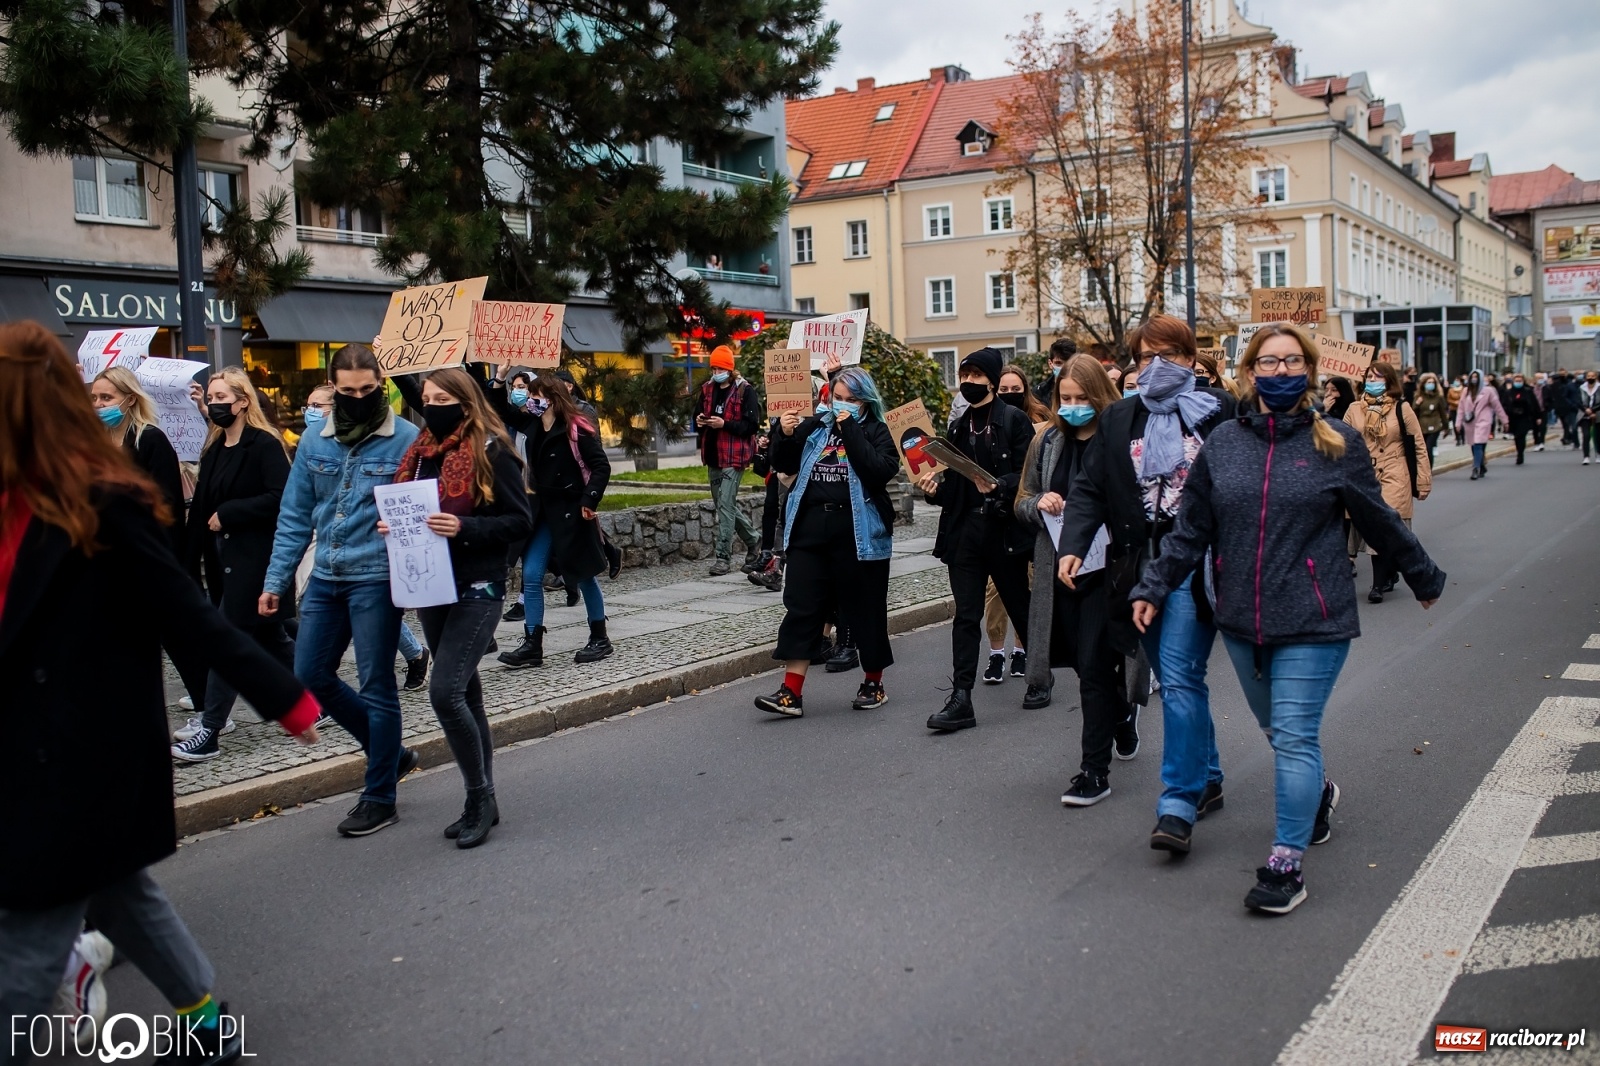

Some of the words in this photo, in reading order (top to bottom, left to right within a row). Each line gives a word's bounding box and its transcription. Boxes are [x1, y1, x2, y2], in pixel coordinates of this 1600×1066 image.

[55, 284, 166, 320] SALON
[176, 292, 236, 323] NU
[401, 284, 457, 318] WARA
[1261, 312, 1288, 322] PRAWA
[1290, 309, 1323, 322] KOBIET
[402, 313, 443, 343] OD
[807, 323, 849, 337] PIEKŁO
[474, 324, 519, 342] NASZYCH
[522, 325, 560, 349] PRAW
[805, 339, 840, 354] KOBIET
[376, 338, 457, 371] KOBIET
[773, 353, 801, 364] POLAND
[886, 412, 901, 423] KAJA
[821, 472, 842, 482] TOUR
